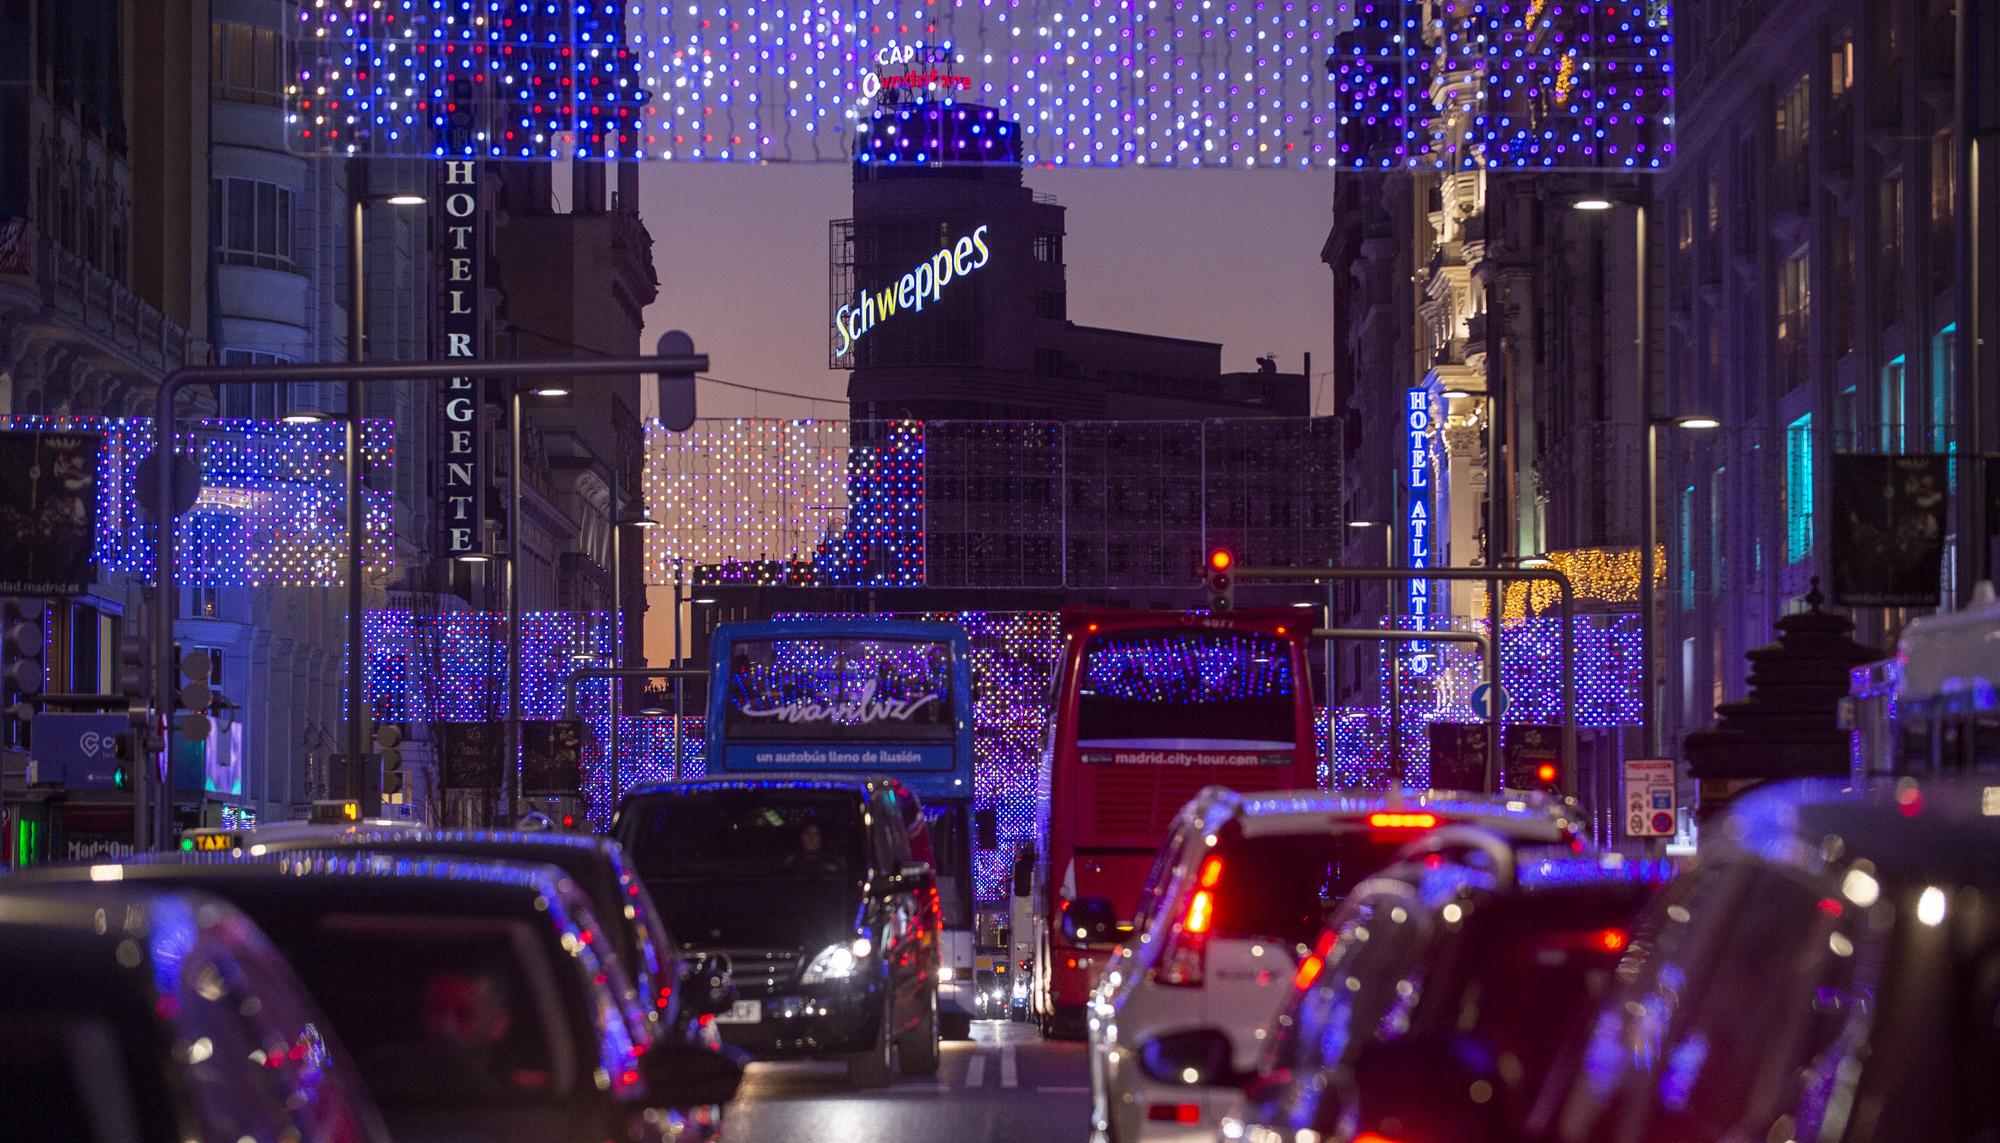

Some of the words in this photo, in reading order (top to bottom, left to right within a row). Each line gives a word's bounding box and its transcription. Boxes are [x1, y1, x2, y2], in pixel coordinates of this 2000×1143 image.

[880, 69, 972, 91] vodafone
[445, 160, 475, 315] HOTEL
[836, 224, 989, 358] Schweppes
[1409, 391, 1427, 487] HOTEL
[756, 753, 773, 763] un
[775, 751, 827, 763] autobús
[828, 751, 860, 763] lleno
[862, 751, 878, 763] de
[879, 751, 922, 763] ilusión
[1115, 752, 1259, 767] madrid.city-tour.com
[195, 834, 232, 851] TAXI
